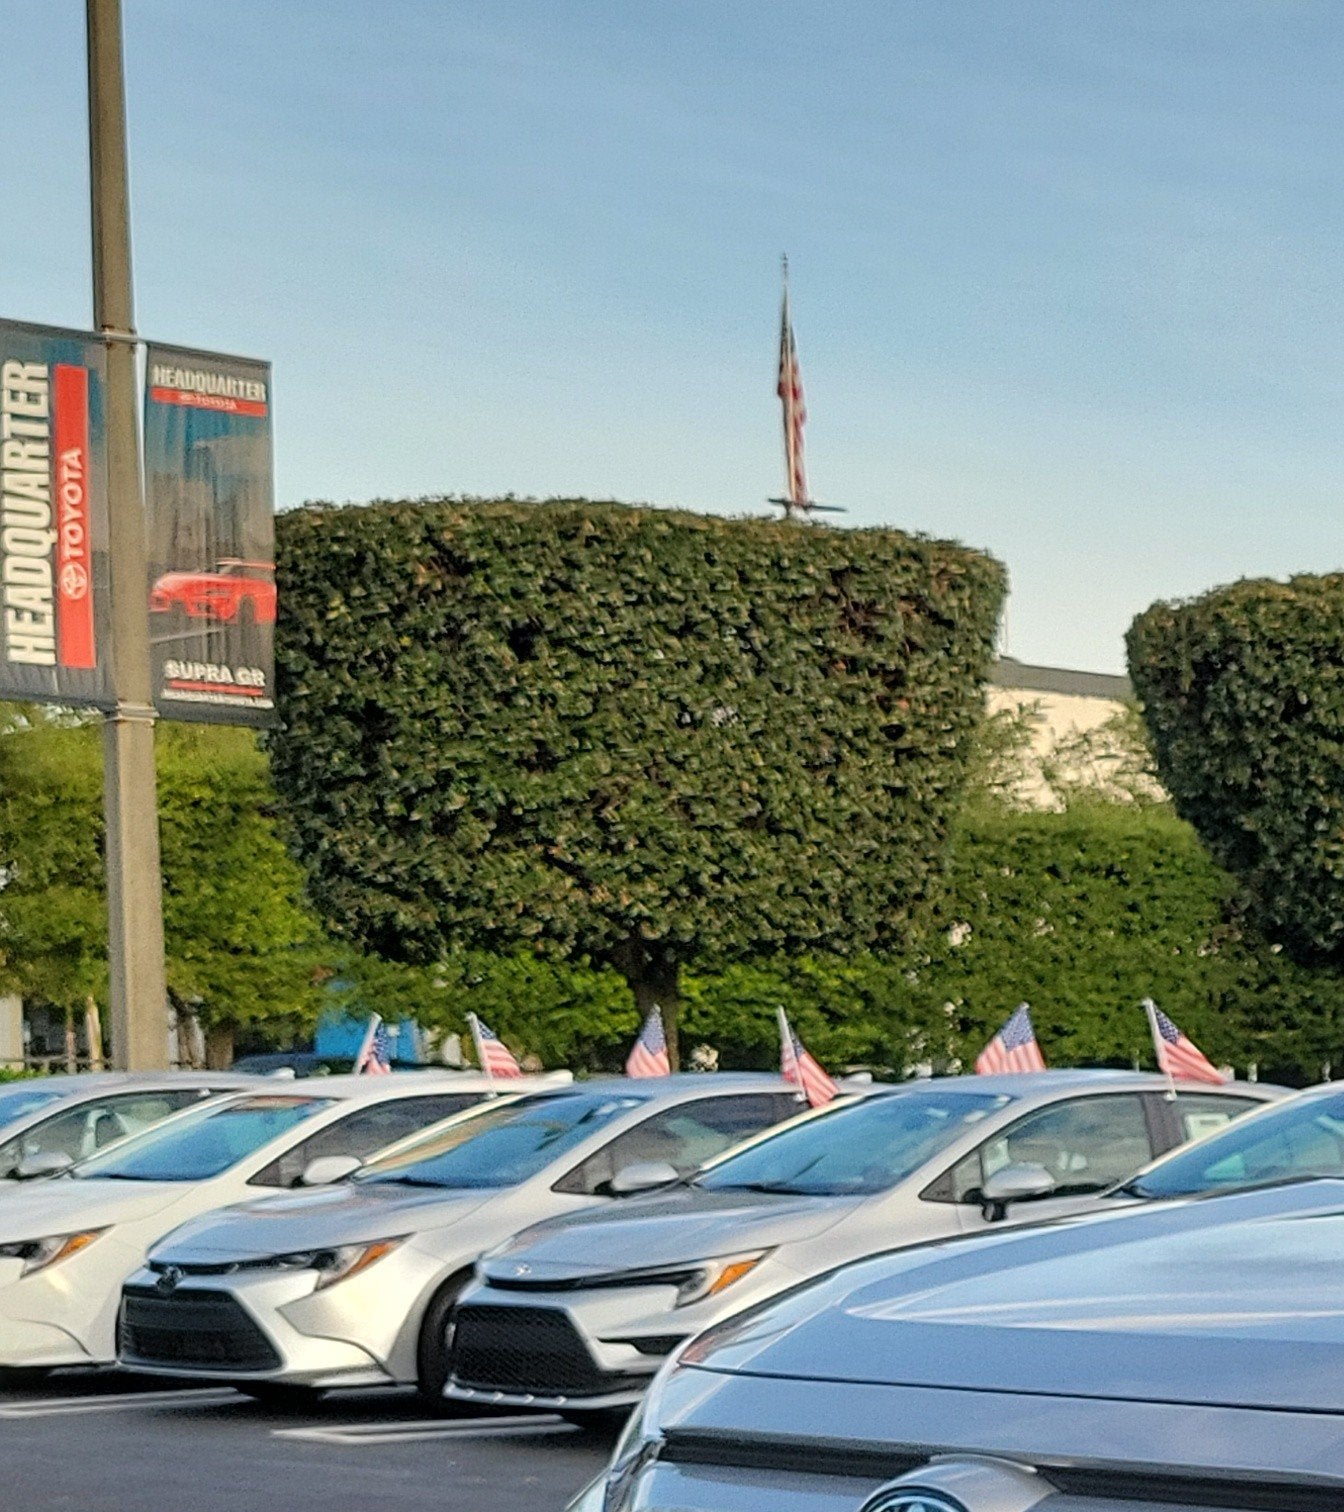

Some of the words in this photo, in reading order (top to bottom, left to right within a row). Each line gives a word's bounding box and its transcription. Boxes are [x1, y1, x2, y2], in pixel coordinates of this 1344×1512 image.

[153, 363, 266, 402] HEADQUARTER
[2, 359, 57, 667] HEADQUARTER
[60, 447, 85, 559] TOYOTA
[163, 658, 235, 683] SUPRA
[234, 666, 267, 687] GR
